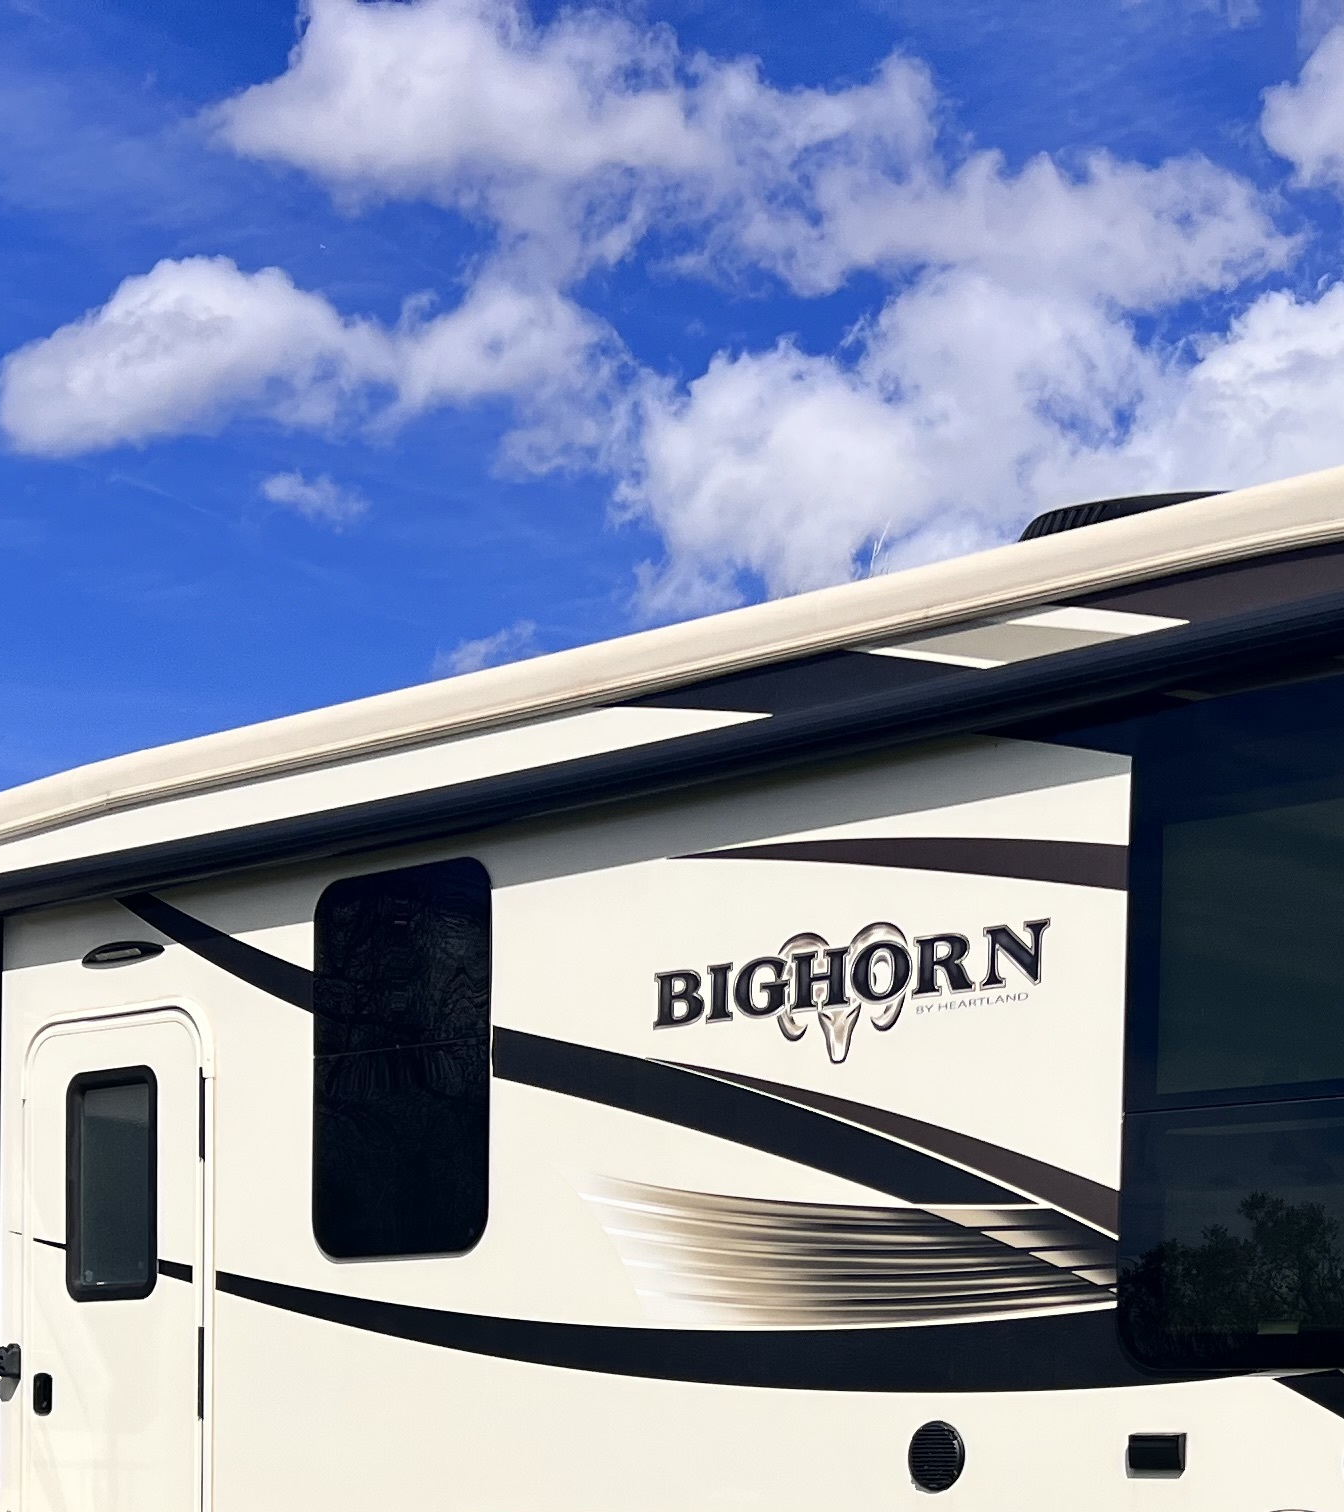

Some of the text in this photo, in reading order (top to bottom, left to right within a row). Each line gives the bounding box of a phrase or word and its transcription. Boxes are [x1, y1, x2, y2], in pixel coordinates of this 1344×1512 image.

[653, 917, 1052, 1030] BIGHORN
[915, 992, 1029, 1015] BY HEARTLAND
